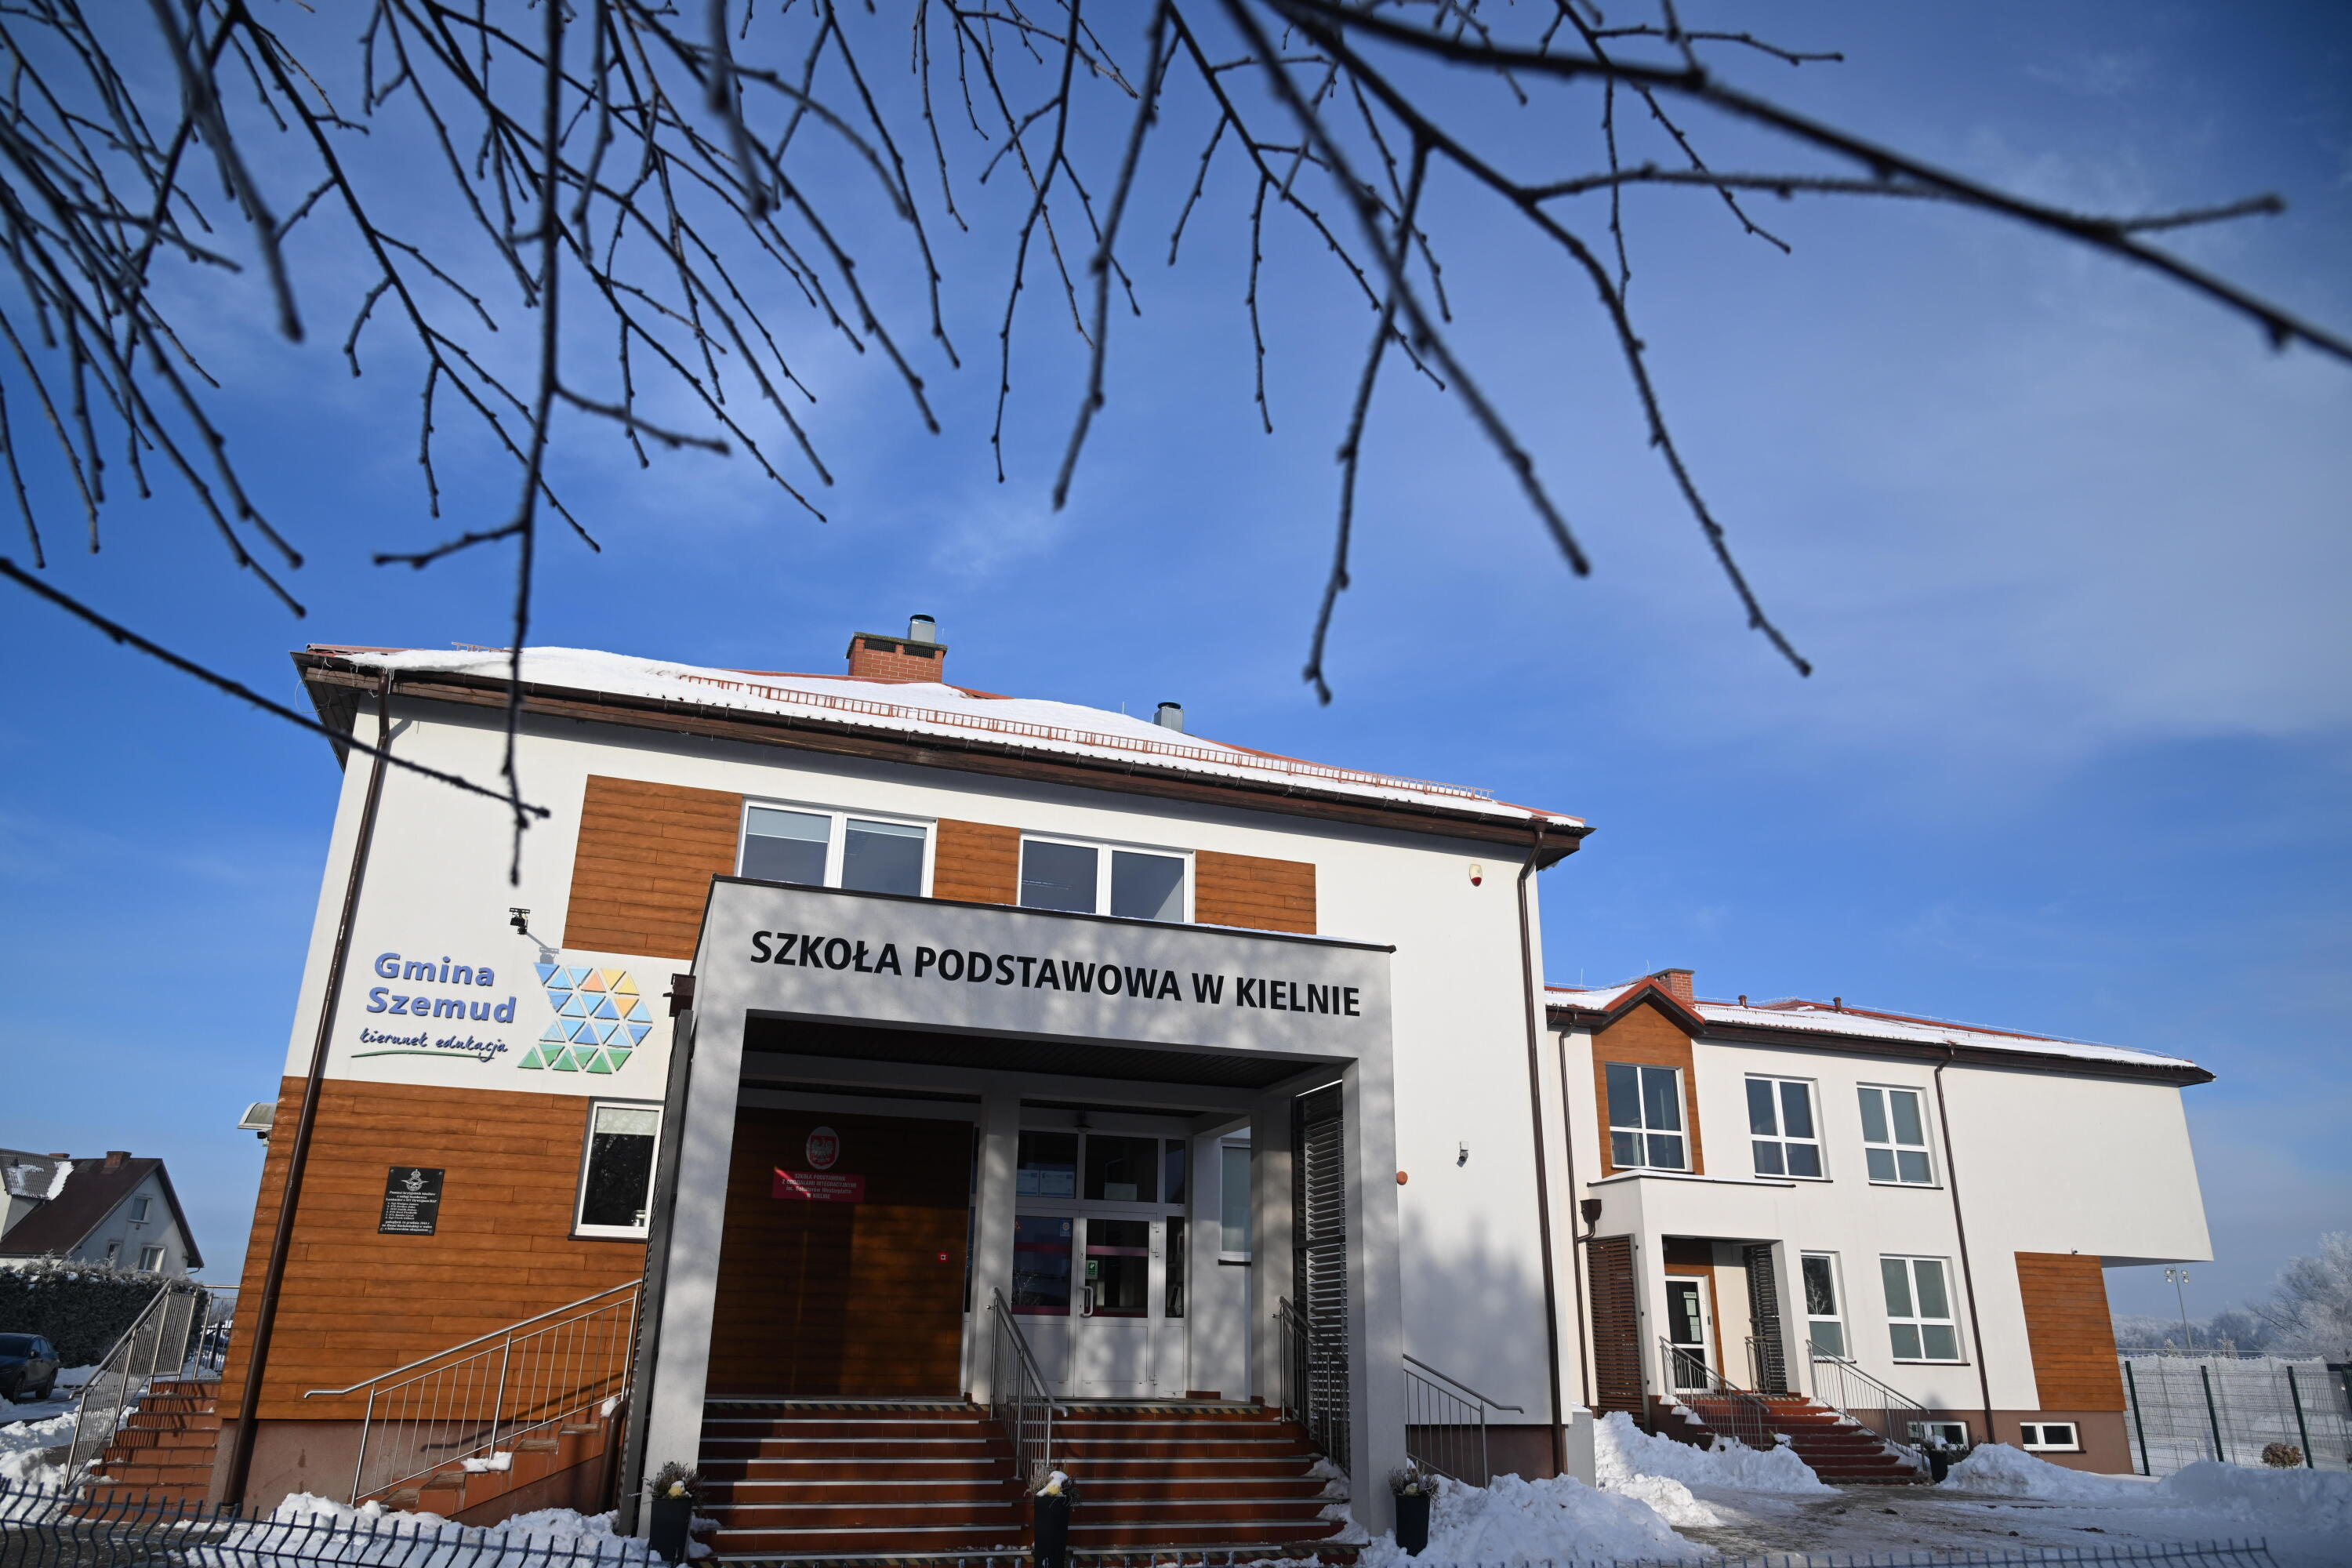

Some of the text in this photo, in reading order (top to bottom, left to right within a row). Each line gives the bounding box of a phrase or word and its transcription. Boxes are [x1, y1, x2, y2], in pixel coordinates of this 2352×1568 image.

[374, 952, 495, 987] Gmina
[751, 931, 1359, 1016] SZKOŁA PODSTAWOWA W KIELNIE
[366, 986, 517, 1023] Szemud
[359, 1028, 508, 1062] kierunek edukacja
